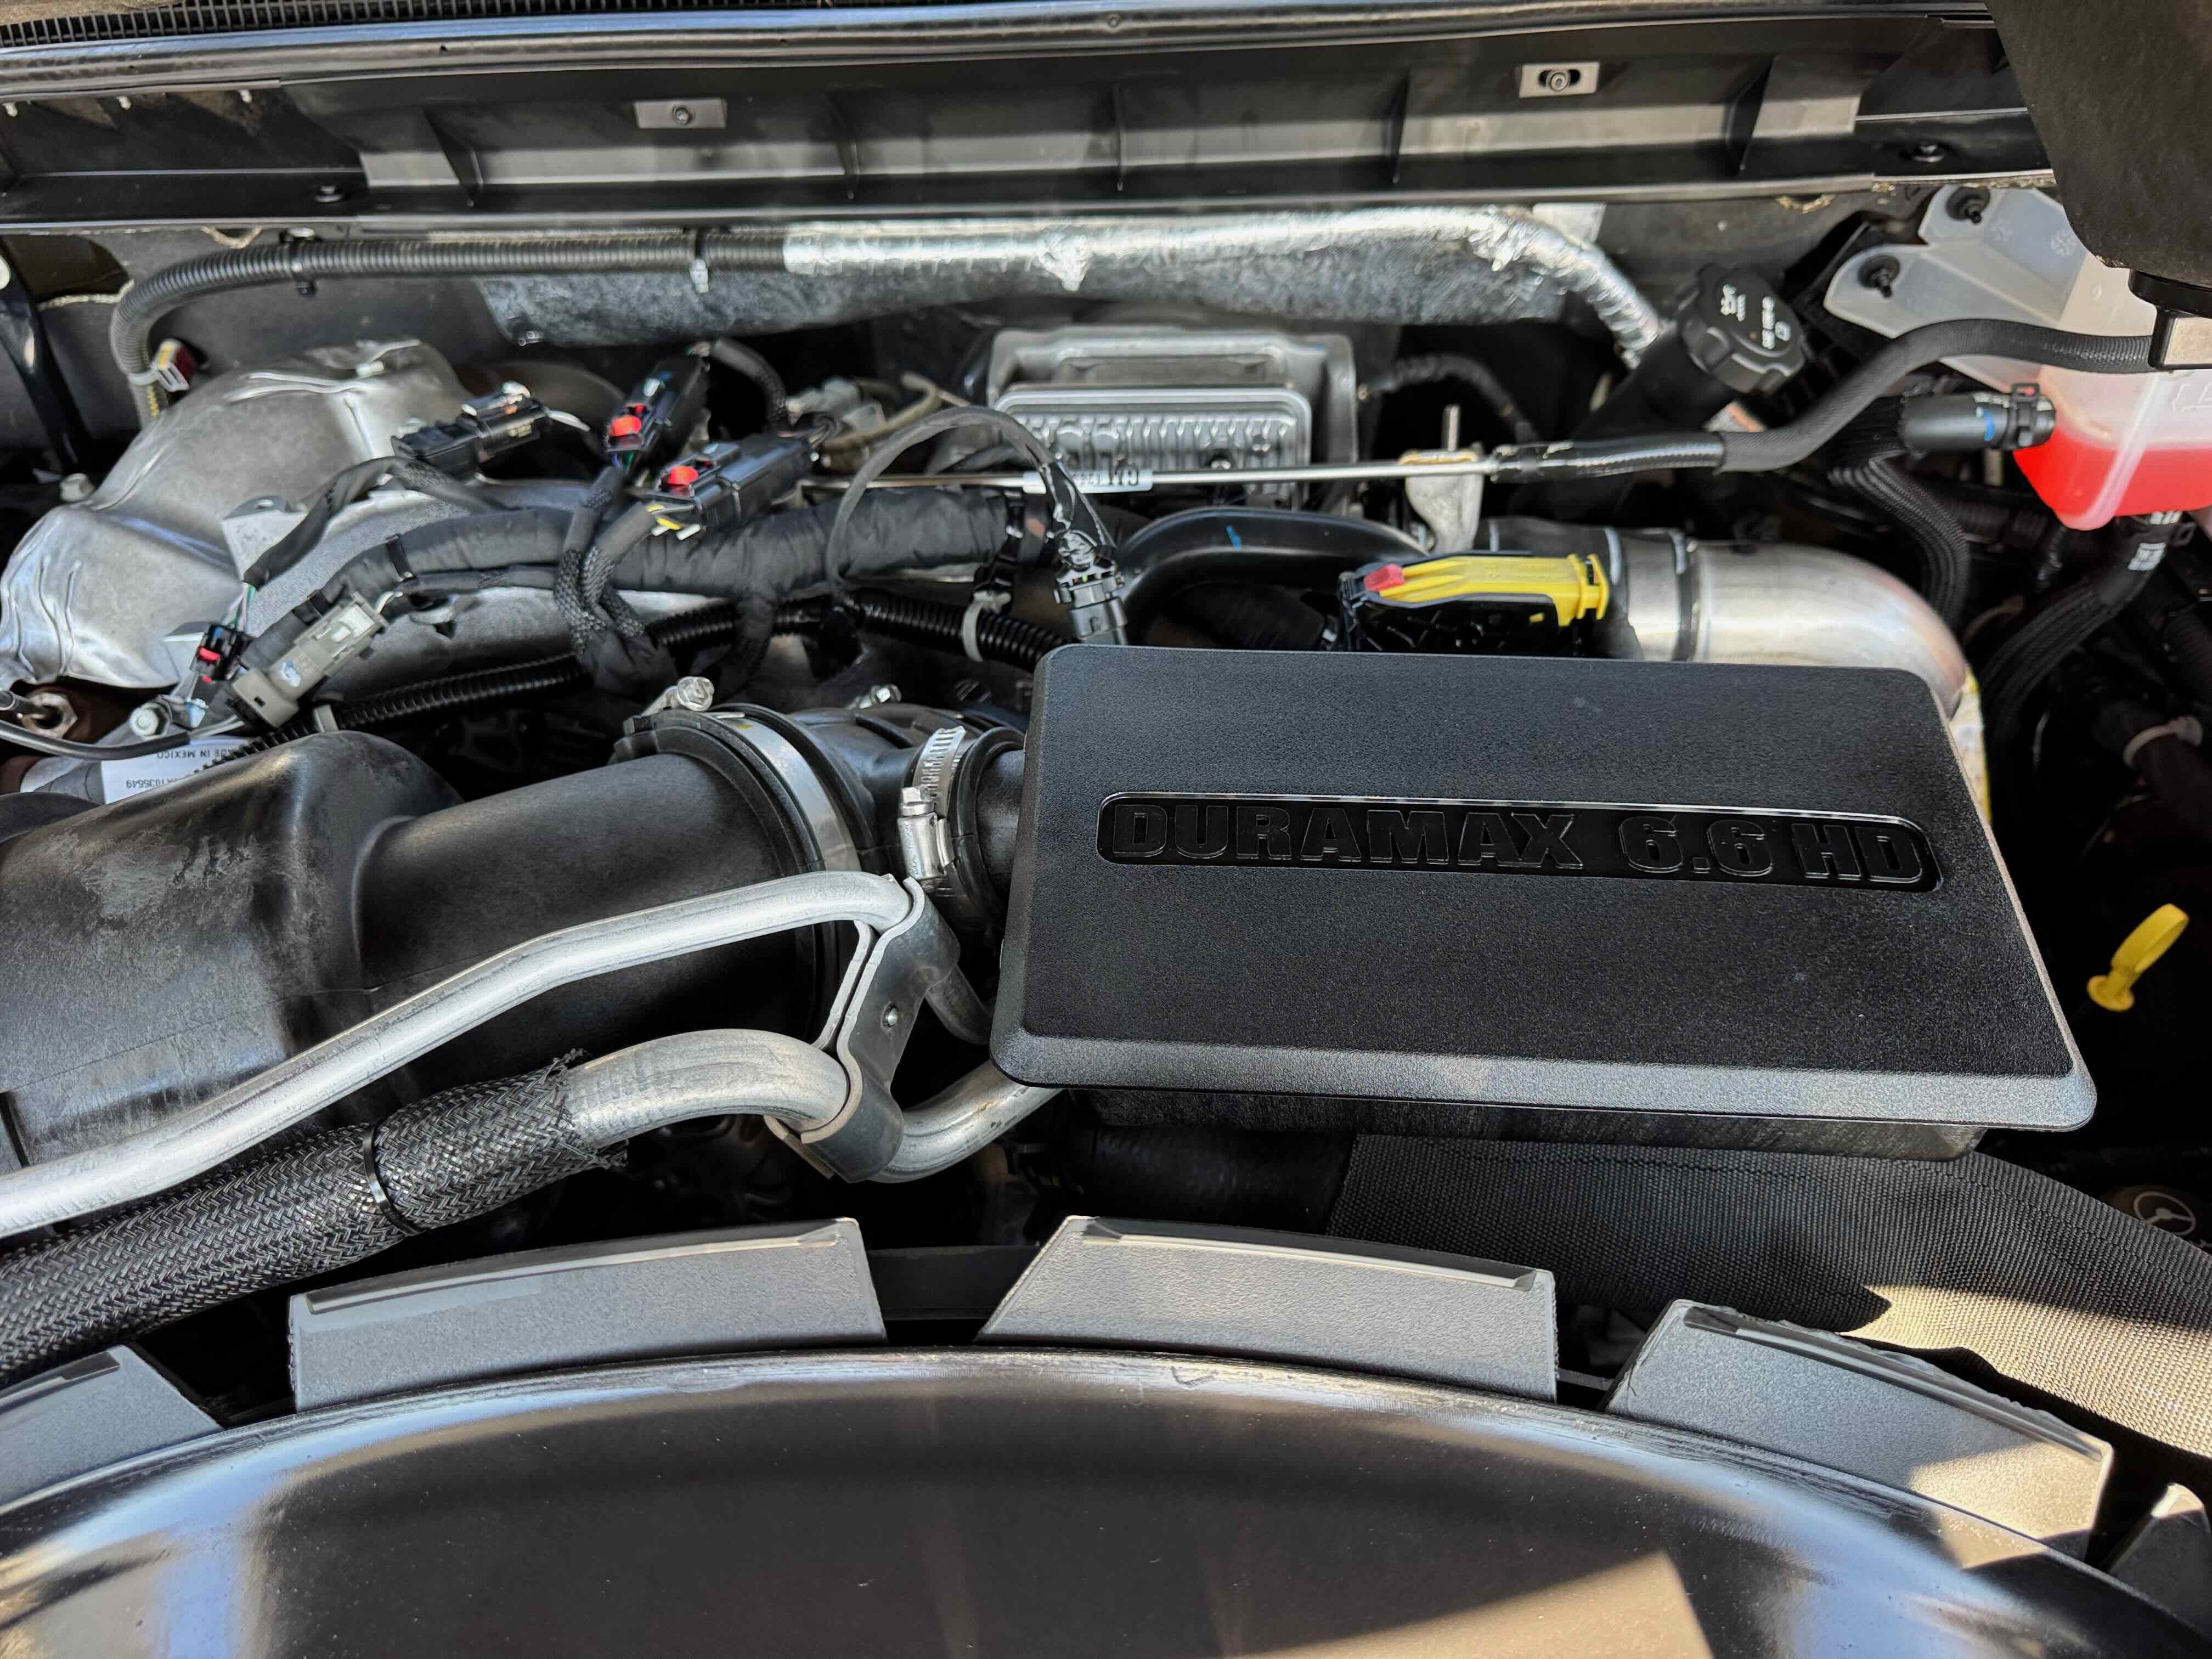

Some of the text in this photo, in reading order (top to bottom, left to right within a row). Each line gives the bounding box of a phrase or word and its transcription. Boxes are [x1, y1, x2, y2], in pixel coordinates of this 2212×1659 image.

[157, 749, 196, 759] MEXICO
[200, 749, 211, 758] IN
[1112, 804, 1923, 884] DURAMAX 6.6 HD
